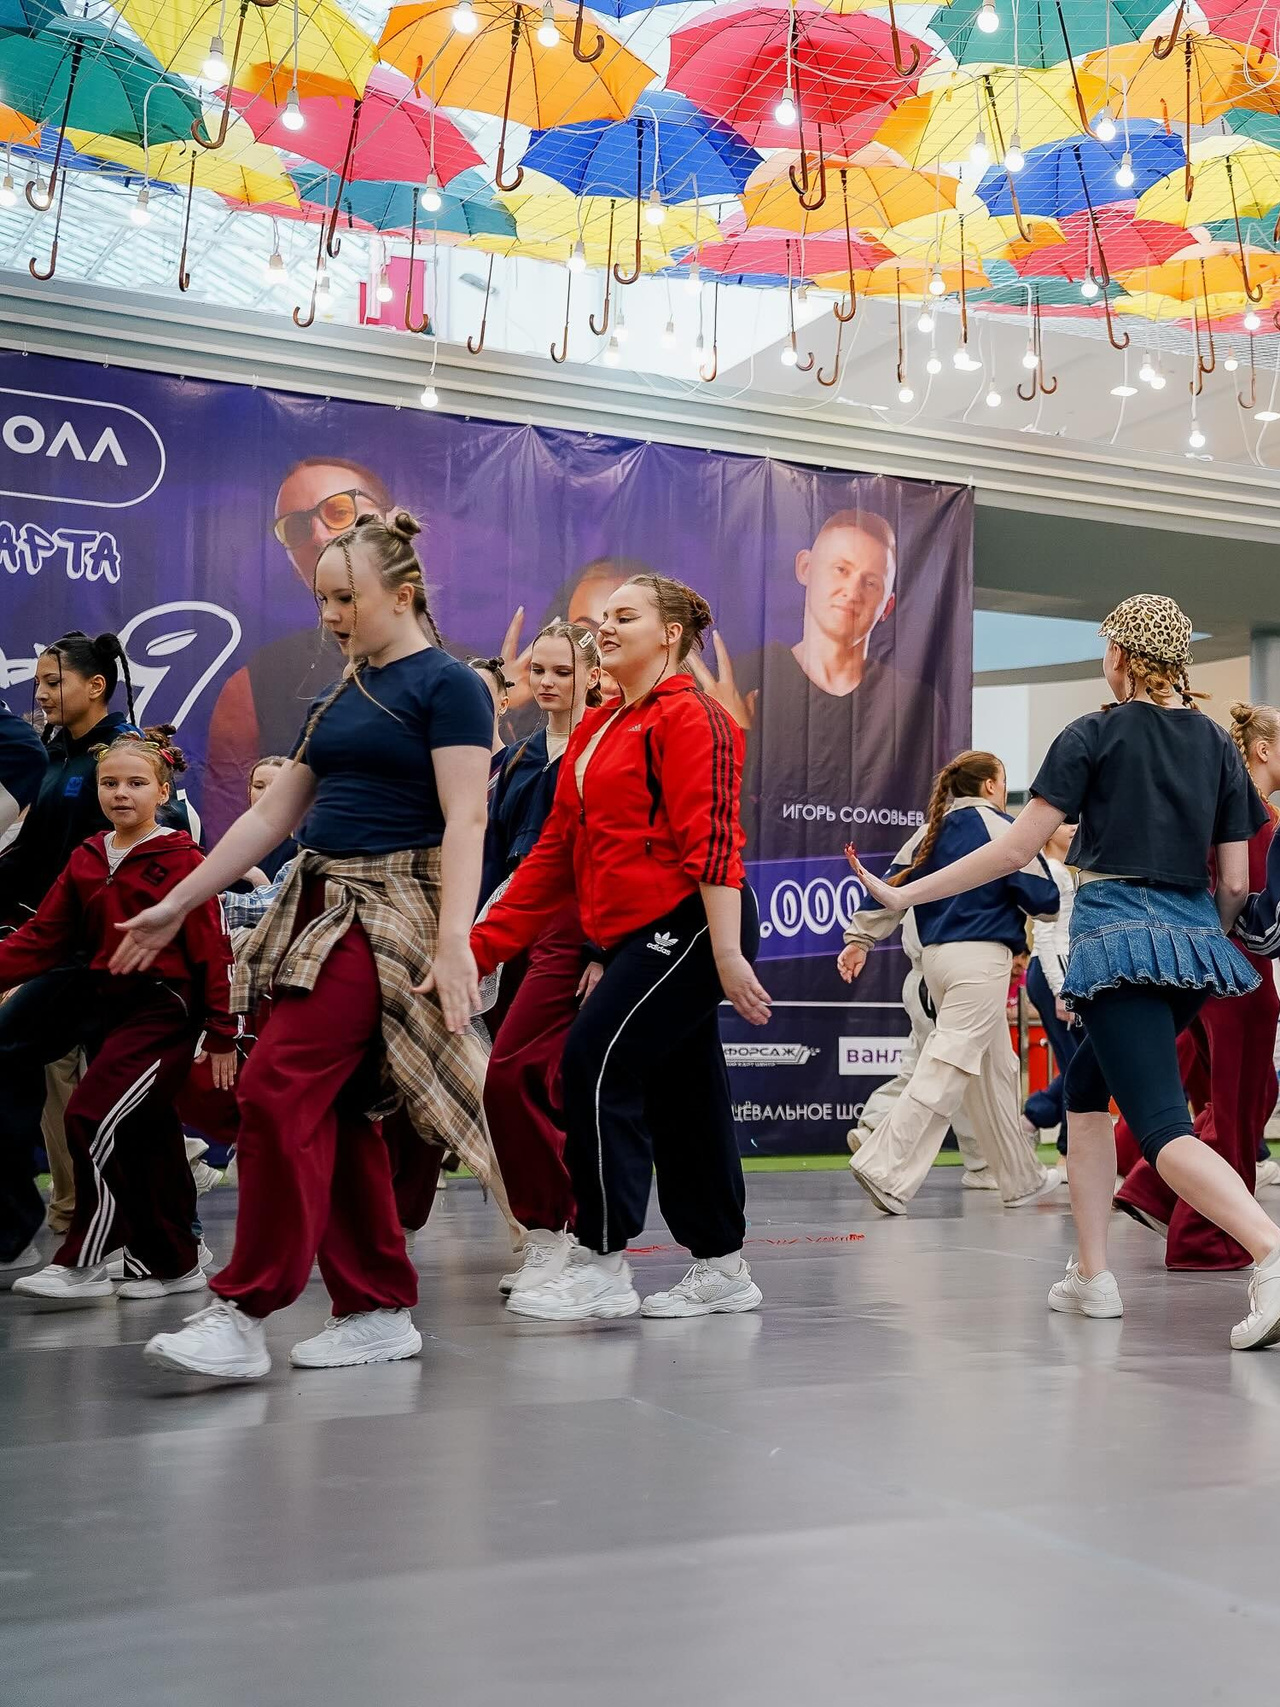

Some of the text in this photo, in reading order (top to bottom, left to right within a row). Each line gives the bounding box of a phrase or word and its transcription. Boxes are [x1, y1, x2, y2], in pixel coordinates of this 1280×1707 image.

[783, 803, 926, 827] ИГОРЬ СОЛОВЬЕВ
[646, 942, 671, 956] adidas
[724, 1047, 796, 1057] ФОРСАЖ
